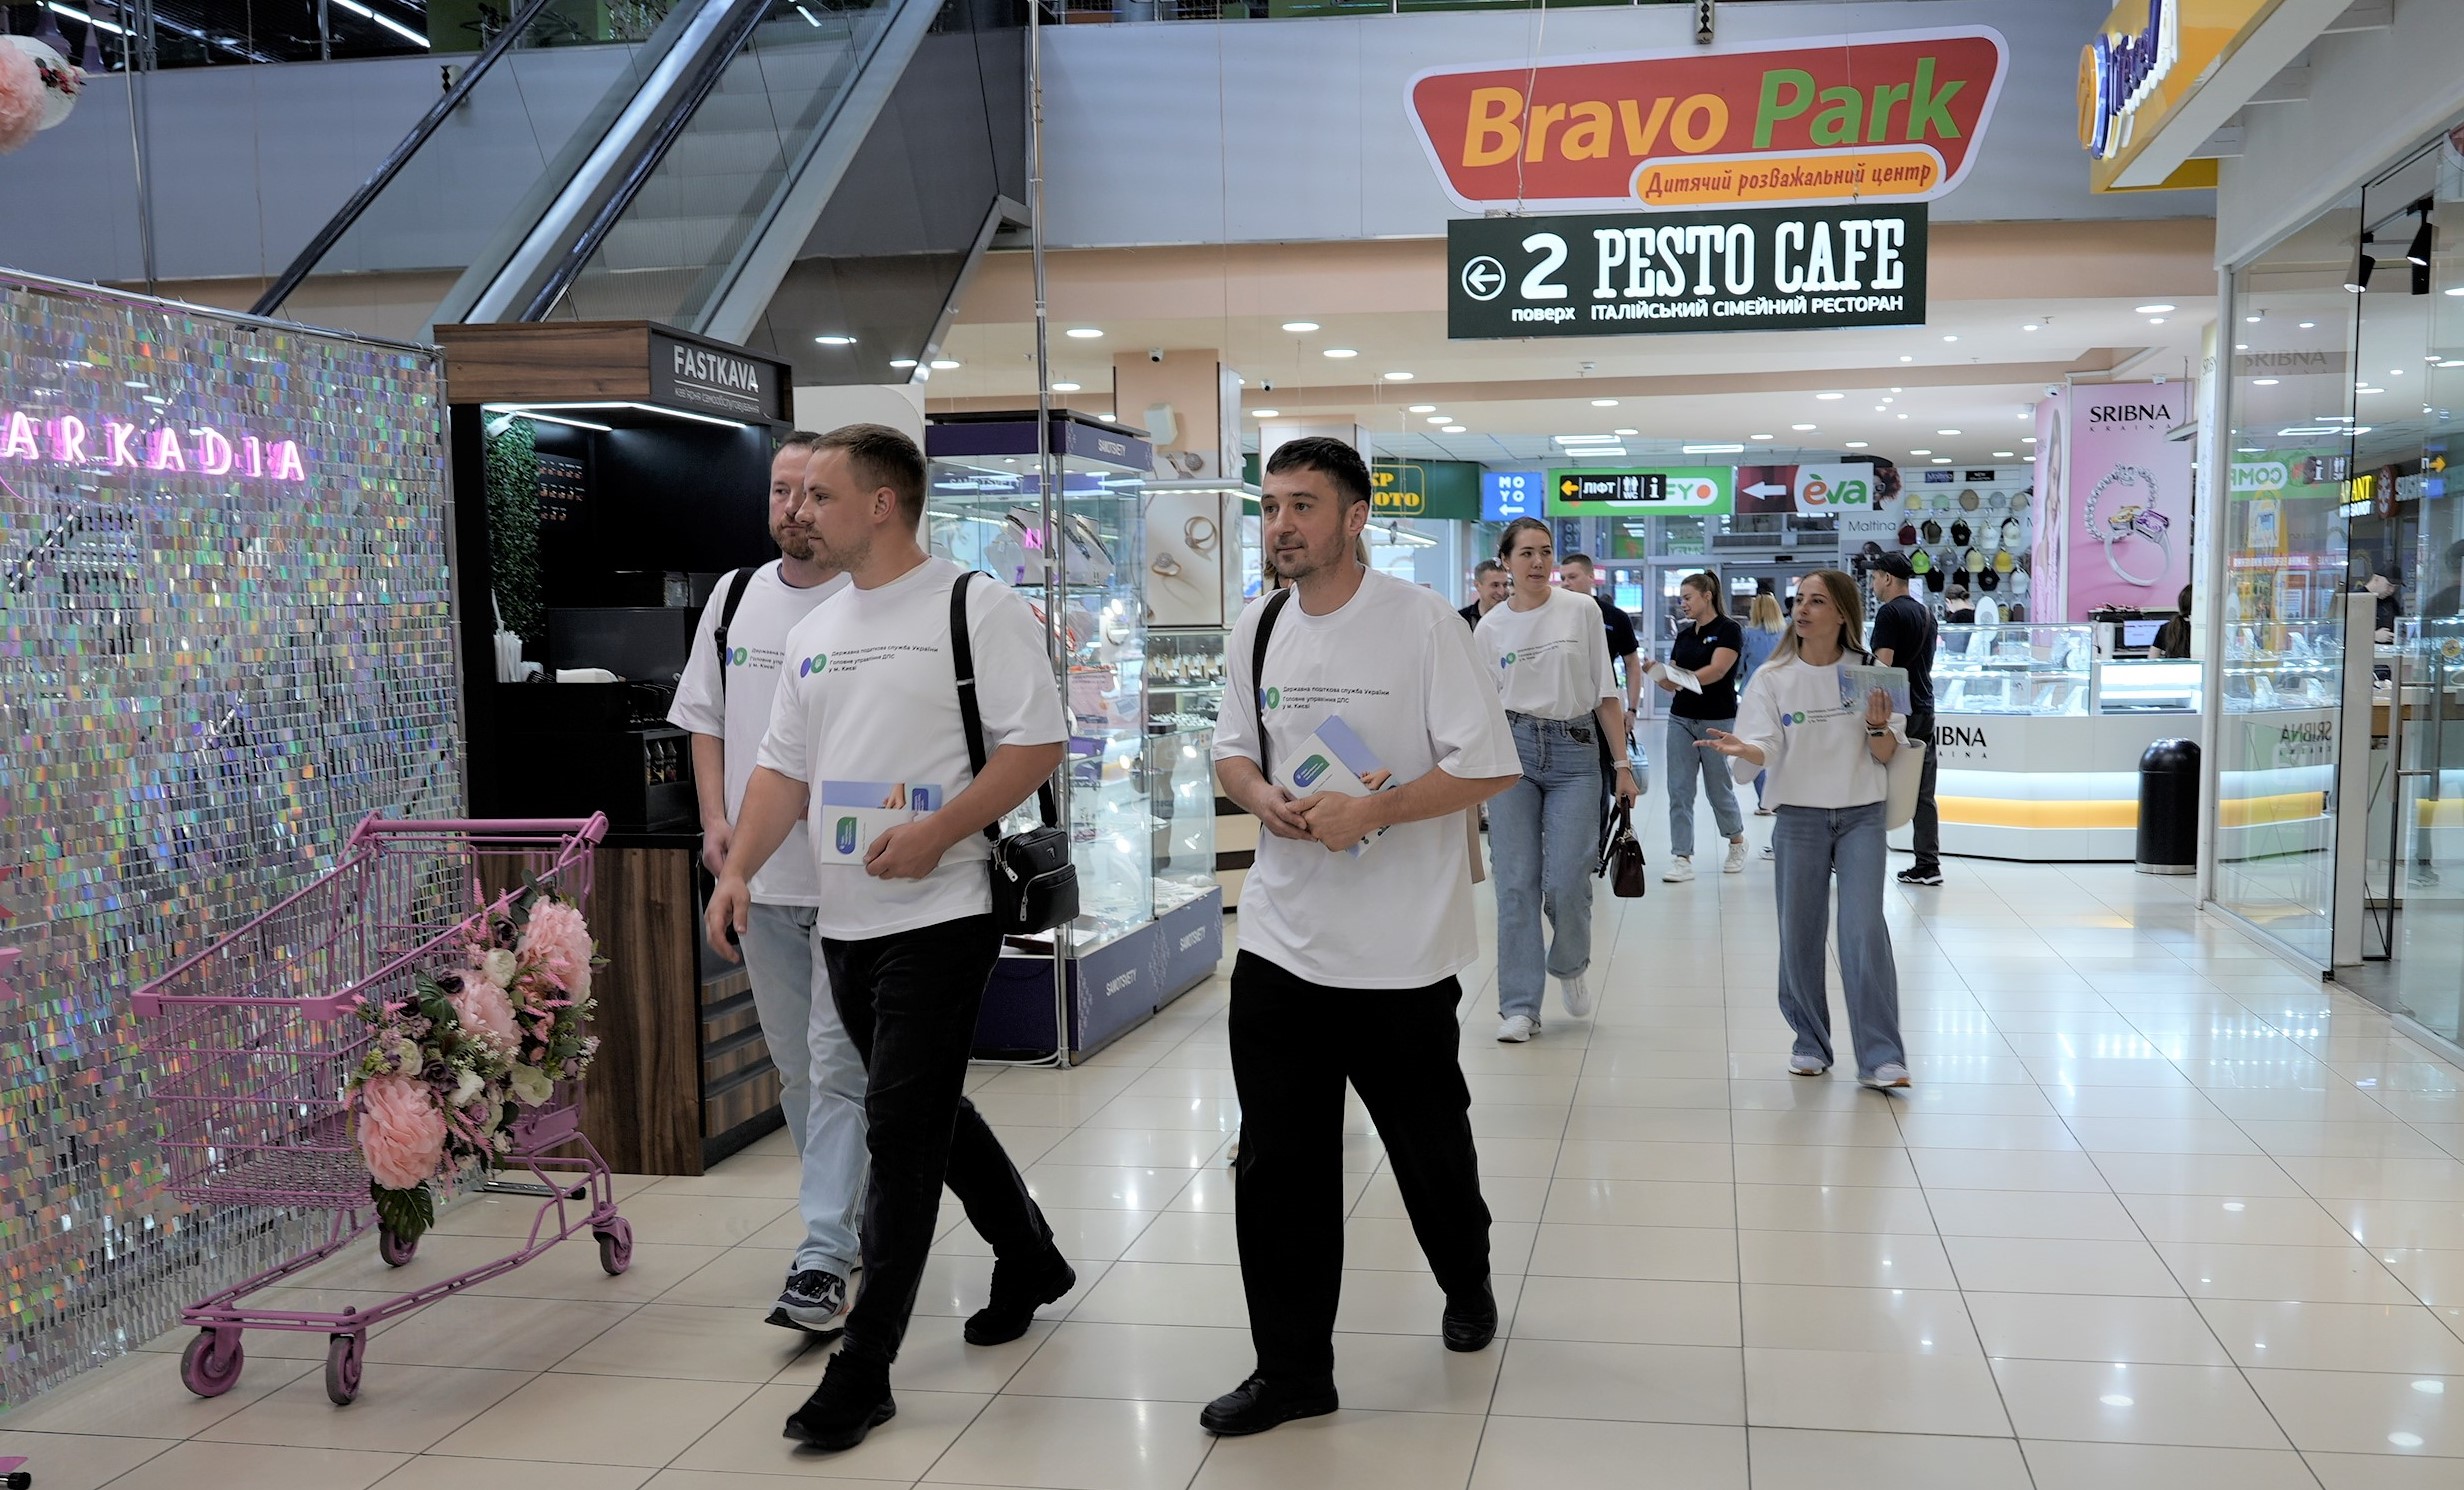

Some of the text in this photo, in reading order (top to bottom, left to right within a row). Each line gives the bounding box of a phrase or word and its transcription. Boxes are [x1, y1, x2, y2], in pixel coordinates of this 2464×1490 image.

[1462, 57, 1967, 167] Bravo Park
[1645, 163, 1931, 198] Дитячий розважальний центр
[1520, 232, 1568, 300] 2
[1592, 218, 1905, 299] PESTO CAFE
[1511, 306, 1576, 325] поверх
[1591, 295, 1904, 320] ІТАЛІЙСЬКИЙ СІМЕЙНИЙ РЕСТОРАН
[673, 344, 759, 393] FASTKAVA
[2090, 404, 2171, 423] SRIBNA
[2, 411, 305, 481] ARKADIA
[1499, 476, 1525, 489] MO
[1373, 491, 1420, 507] ОТО
[1499, 490, 1525, 502] YO
[1849, 520, 1896, 532] Maltina
[1936, 726, 1987, 747] IBNA
